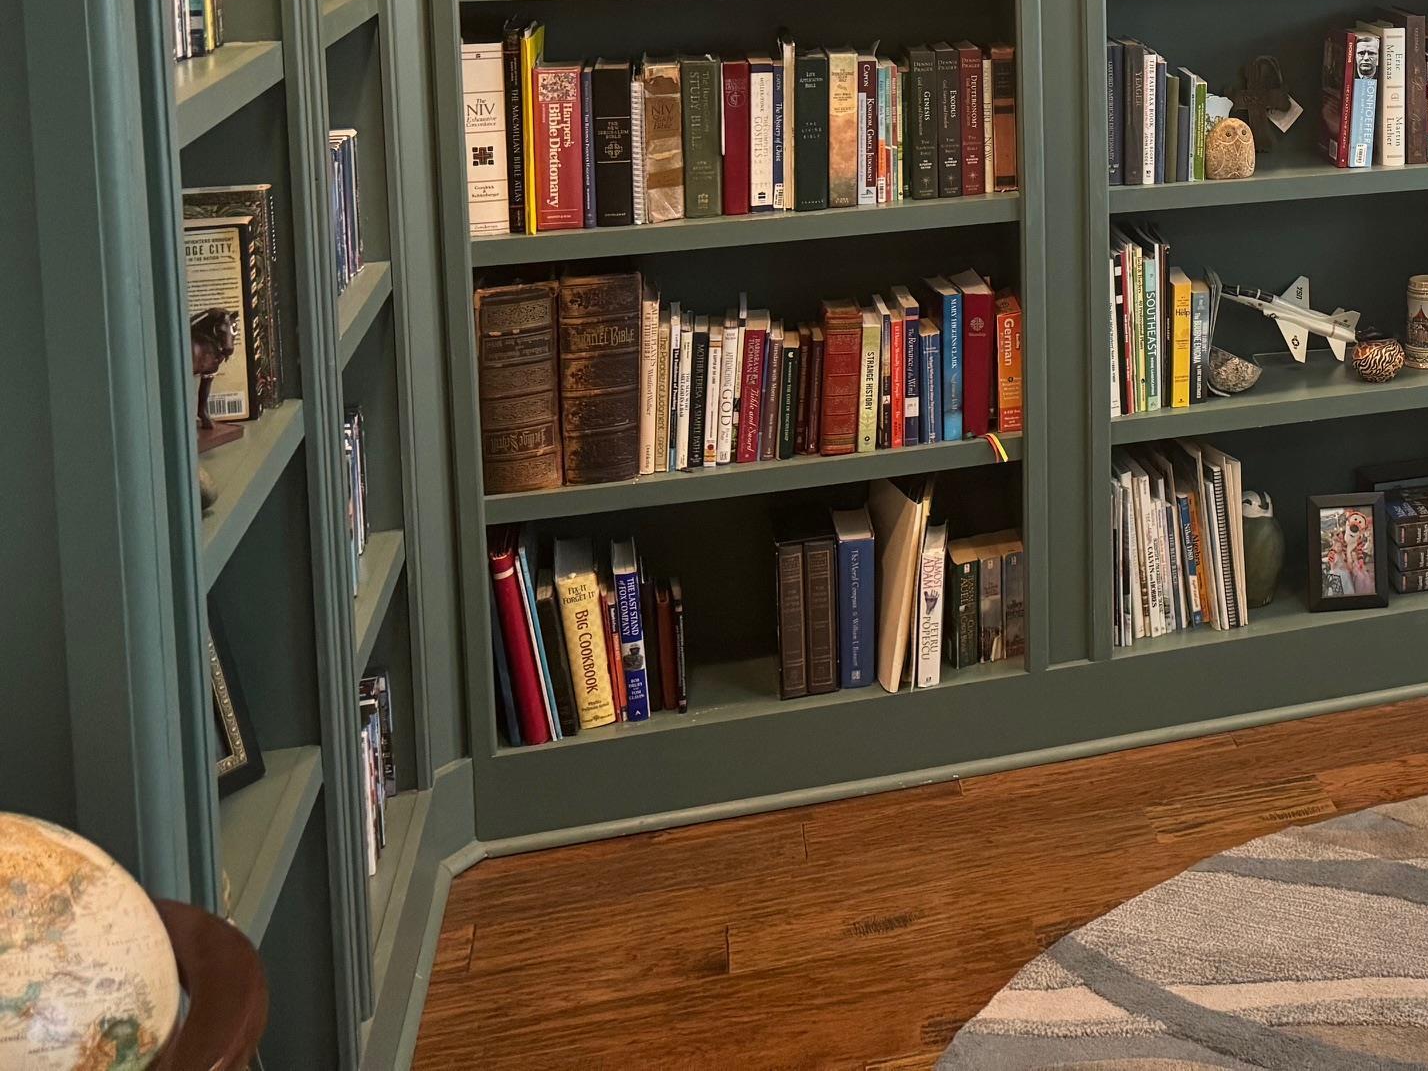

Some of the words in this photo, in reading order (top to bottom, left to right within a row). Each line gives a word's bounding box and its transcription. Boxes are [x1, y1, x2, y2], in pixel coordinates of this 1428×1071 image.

[1386, 44, 1395, 80] Metaxas
[467, 103, 495, 116] NIV
[548, 103, 560, 136] Bible
[562, 103, 573, 148] Harper's
[547, 137, 561, 208] Dictionary
[1146, 292, 1156, 356] SOUTHEAST
[1003, 318, 1014, 366] German
[865, 351, 875, 382] STRANGE
[720, 389, 732, 426] GOD
[865, 383, 874, 411] HISTORY
[922, 558, 933, 589] ADAM
[933, 556, 942, 589] ALMOST
[1148, 546, 1156, 574] CALVIN
[921, 616, 930, 661] POPESCU
[930, 622, 939, 653] PETRU
[578, 633, 598, 694] COOKBOOK
